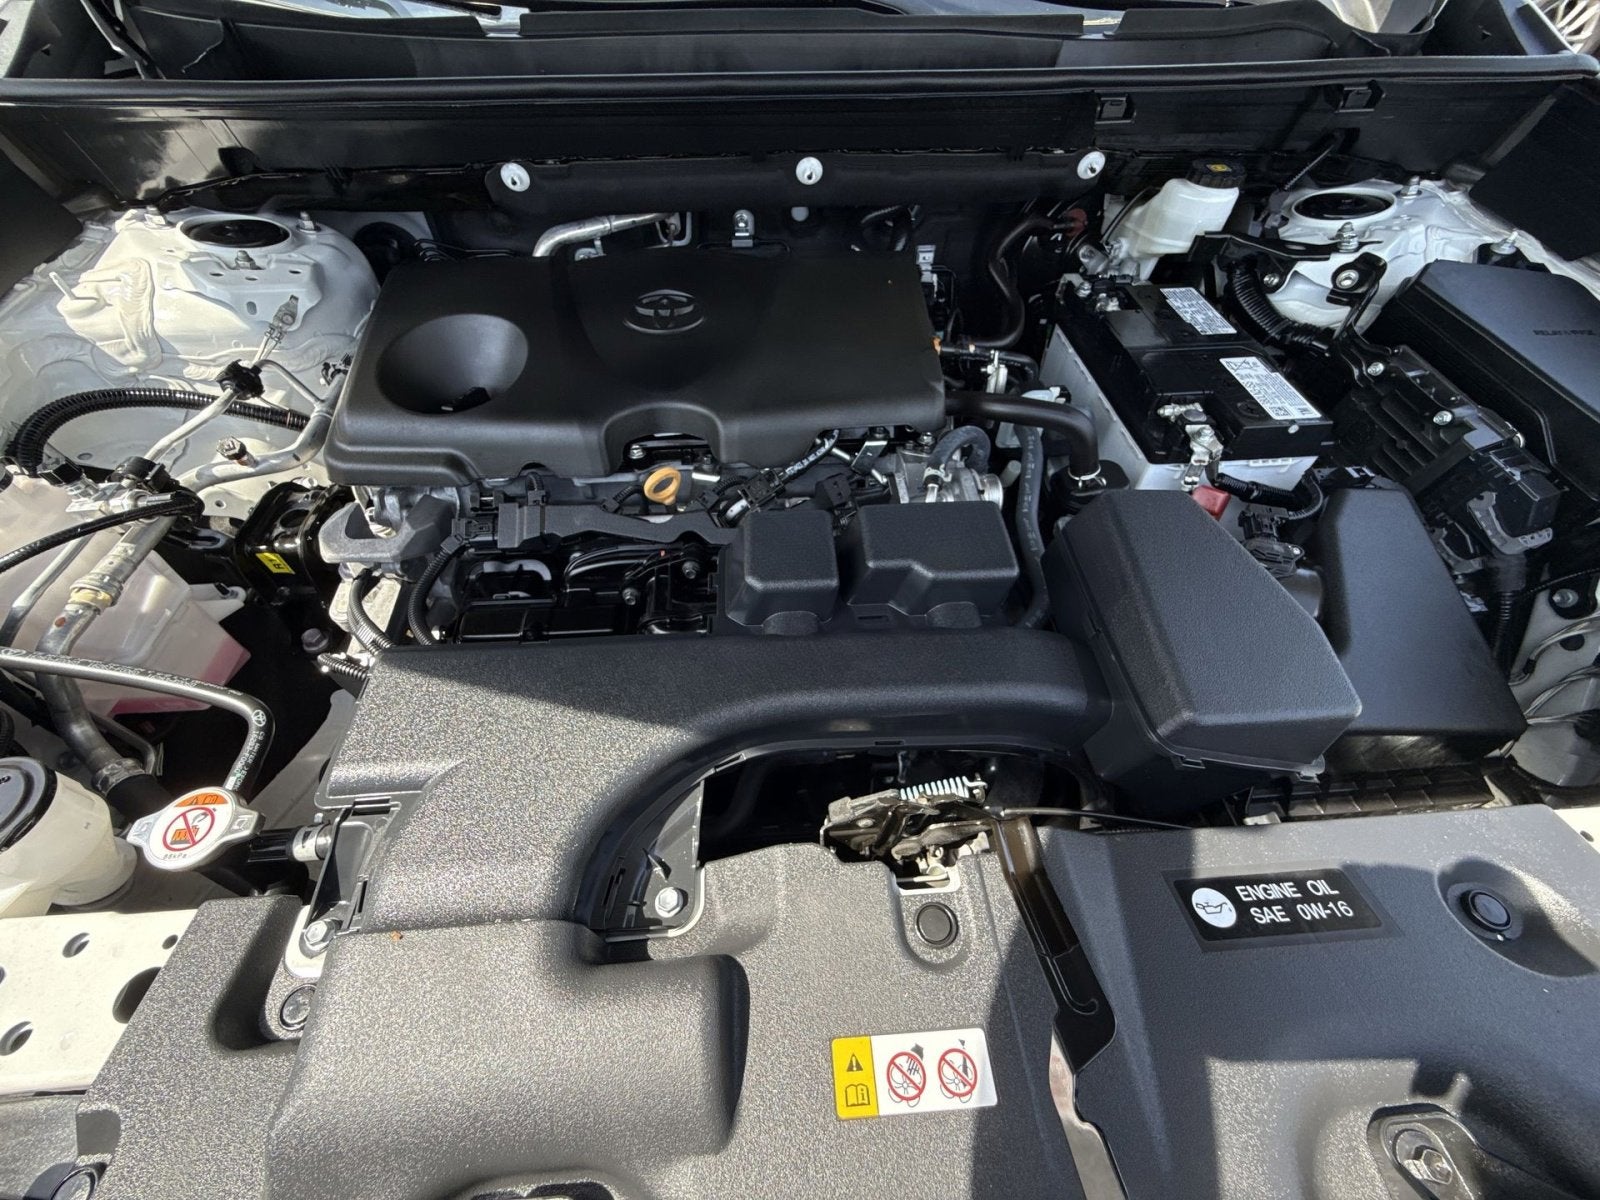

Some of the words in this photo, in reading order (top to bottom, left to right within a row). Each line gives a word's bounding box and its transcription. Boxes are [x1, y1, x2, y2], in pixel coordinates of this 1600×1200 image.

[1234, 881, 1302, 902] ENGINE
[1306, 879, 1340, 896] OIL
[1249, 905, 1291, 924] SAE
[1296, 900, 1354, 921] 0W-16
